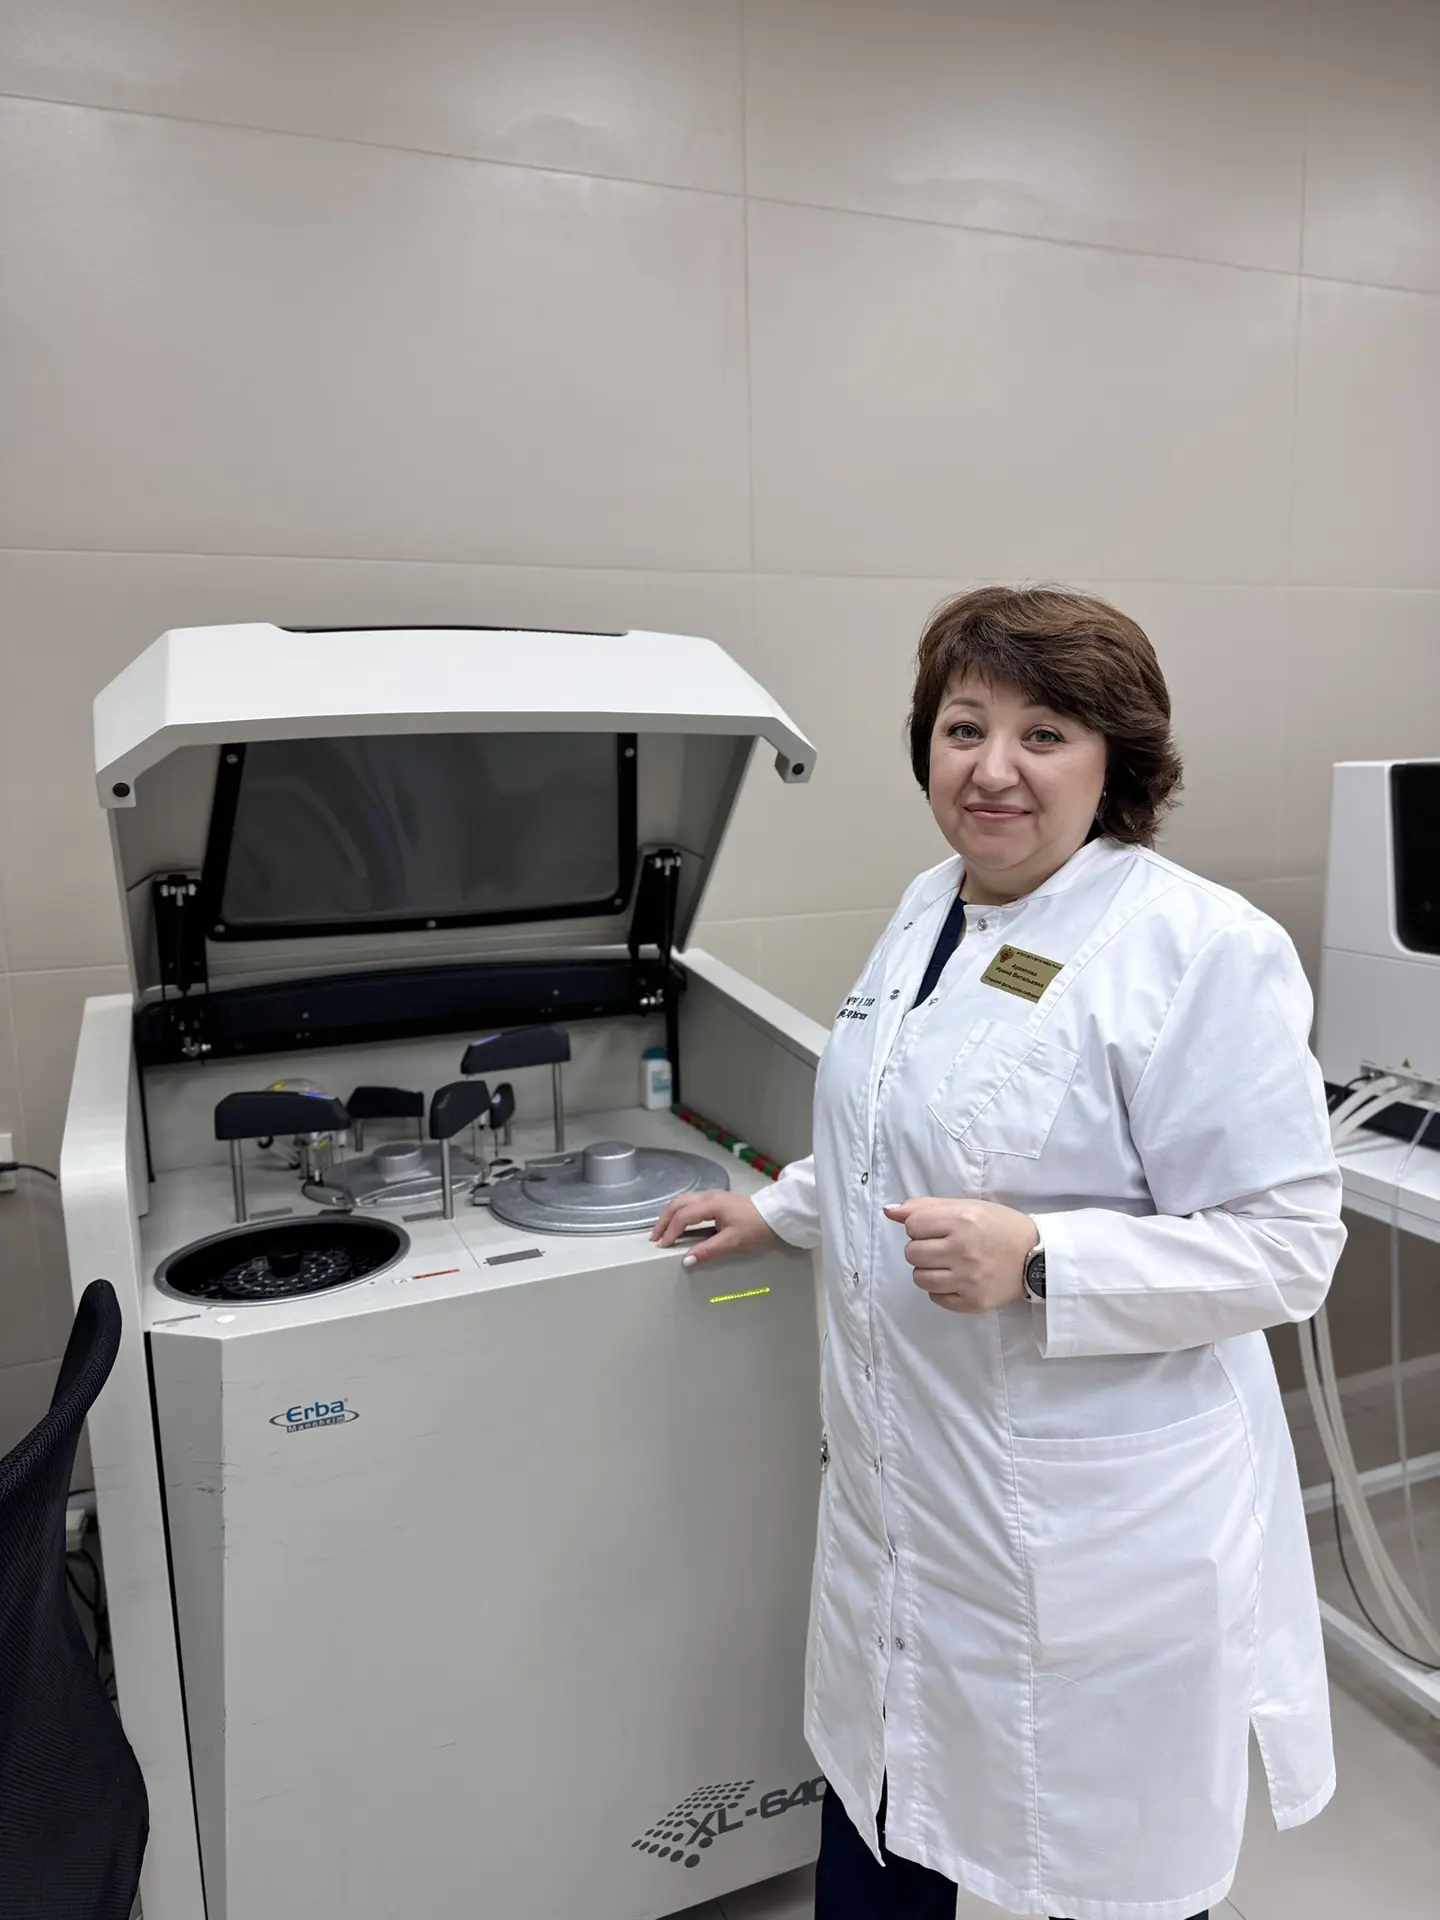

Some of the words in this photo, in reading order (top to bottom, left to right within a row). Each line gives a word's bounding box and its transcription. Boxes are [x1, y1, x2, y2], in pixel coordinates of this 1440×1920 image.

[995, 966, 1012, 977] Ирина
[1012, 972, 1044, 988] Витальевна
[1011, 963, 1037, 977] Архипова
[286, 1400, 344, 1423] Erba
